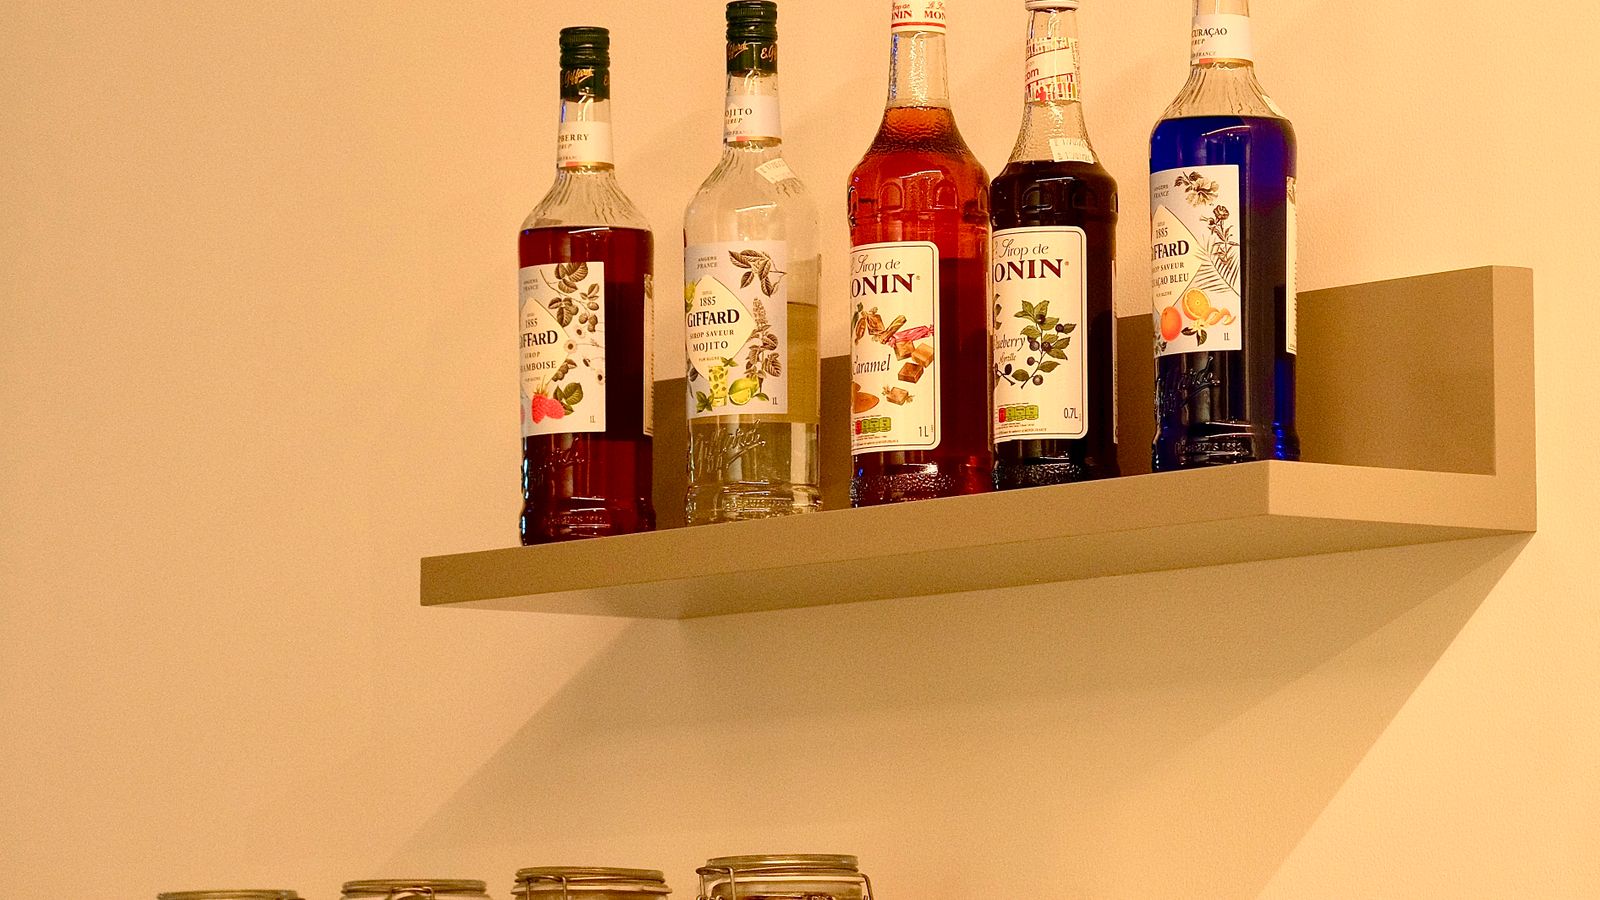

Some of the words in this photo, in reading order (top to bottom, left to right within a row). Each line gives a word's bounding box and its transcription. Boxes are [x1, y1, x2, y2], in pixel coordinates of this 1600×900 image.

[1033, 244, 1049, 255] de
[1152, 240, 1190, 260] FFARD
[885, 259, 901, 271] de
[1169, 272, 1189, 284] BLEU
[699, 295, 716, 307] 1885
[686, 309, 740, 328] GIFFARD
[520, 329, 558, 349] FFARD
[705, 330, 735, 338] SAVEUR
[692, 340, 729, 353] MOJITO
[1064, 408, 1079, 419] 0.7L
